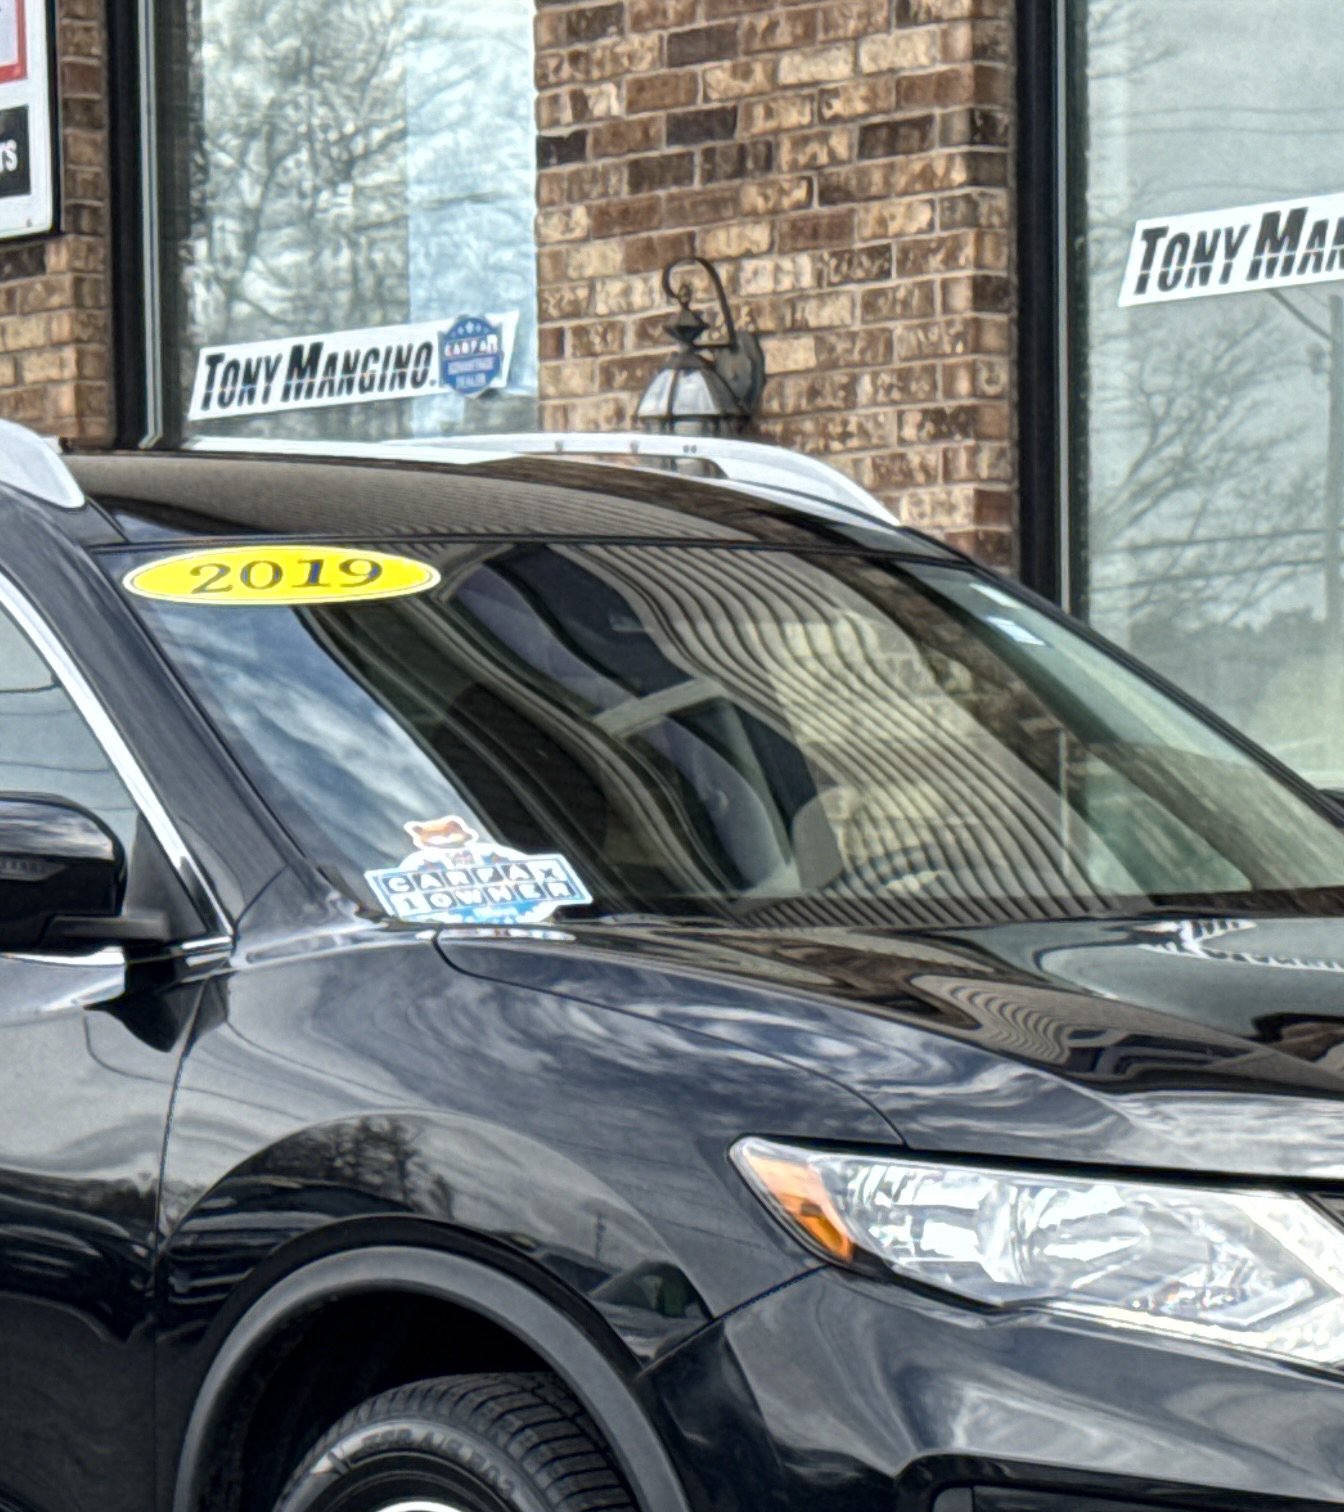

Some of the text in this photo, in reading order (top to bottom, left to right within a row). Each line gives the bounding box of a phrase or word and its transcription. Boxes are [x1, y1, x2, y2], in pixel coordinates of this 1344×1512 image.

[1133, 225, 1251, 295] TONY
[201, 352, 283, 411] TONY
[189, 557, 384, 595] 2019
[387, 861, 560, 892] CARFAX
